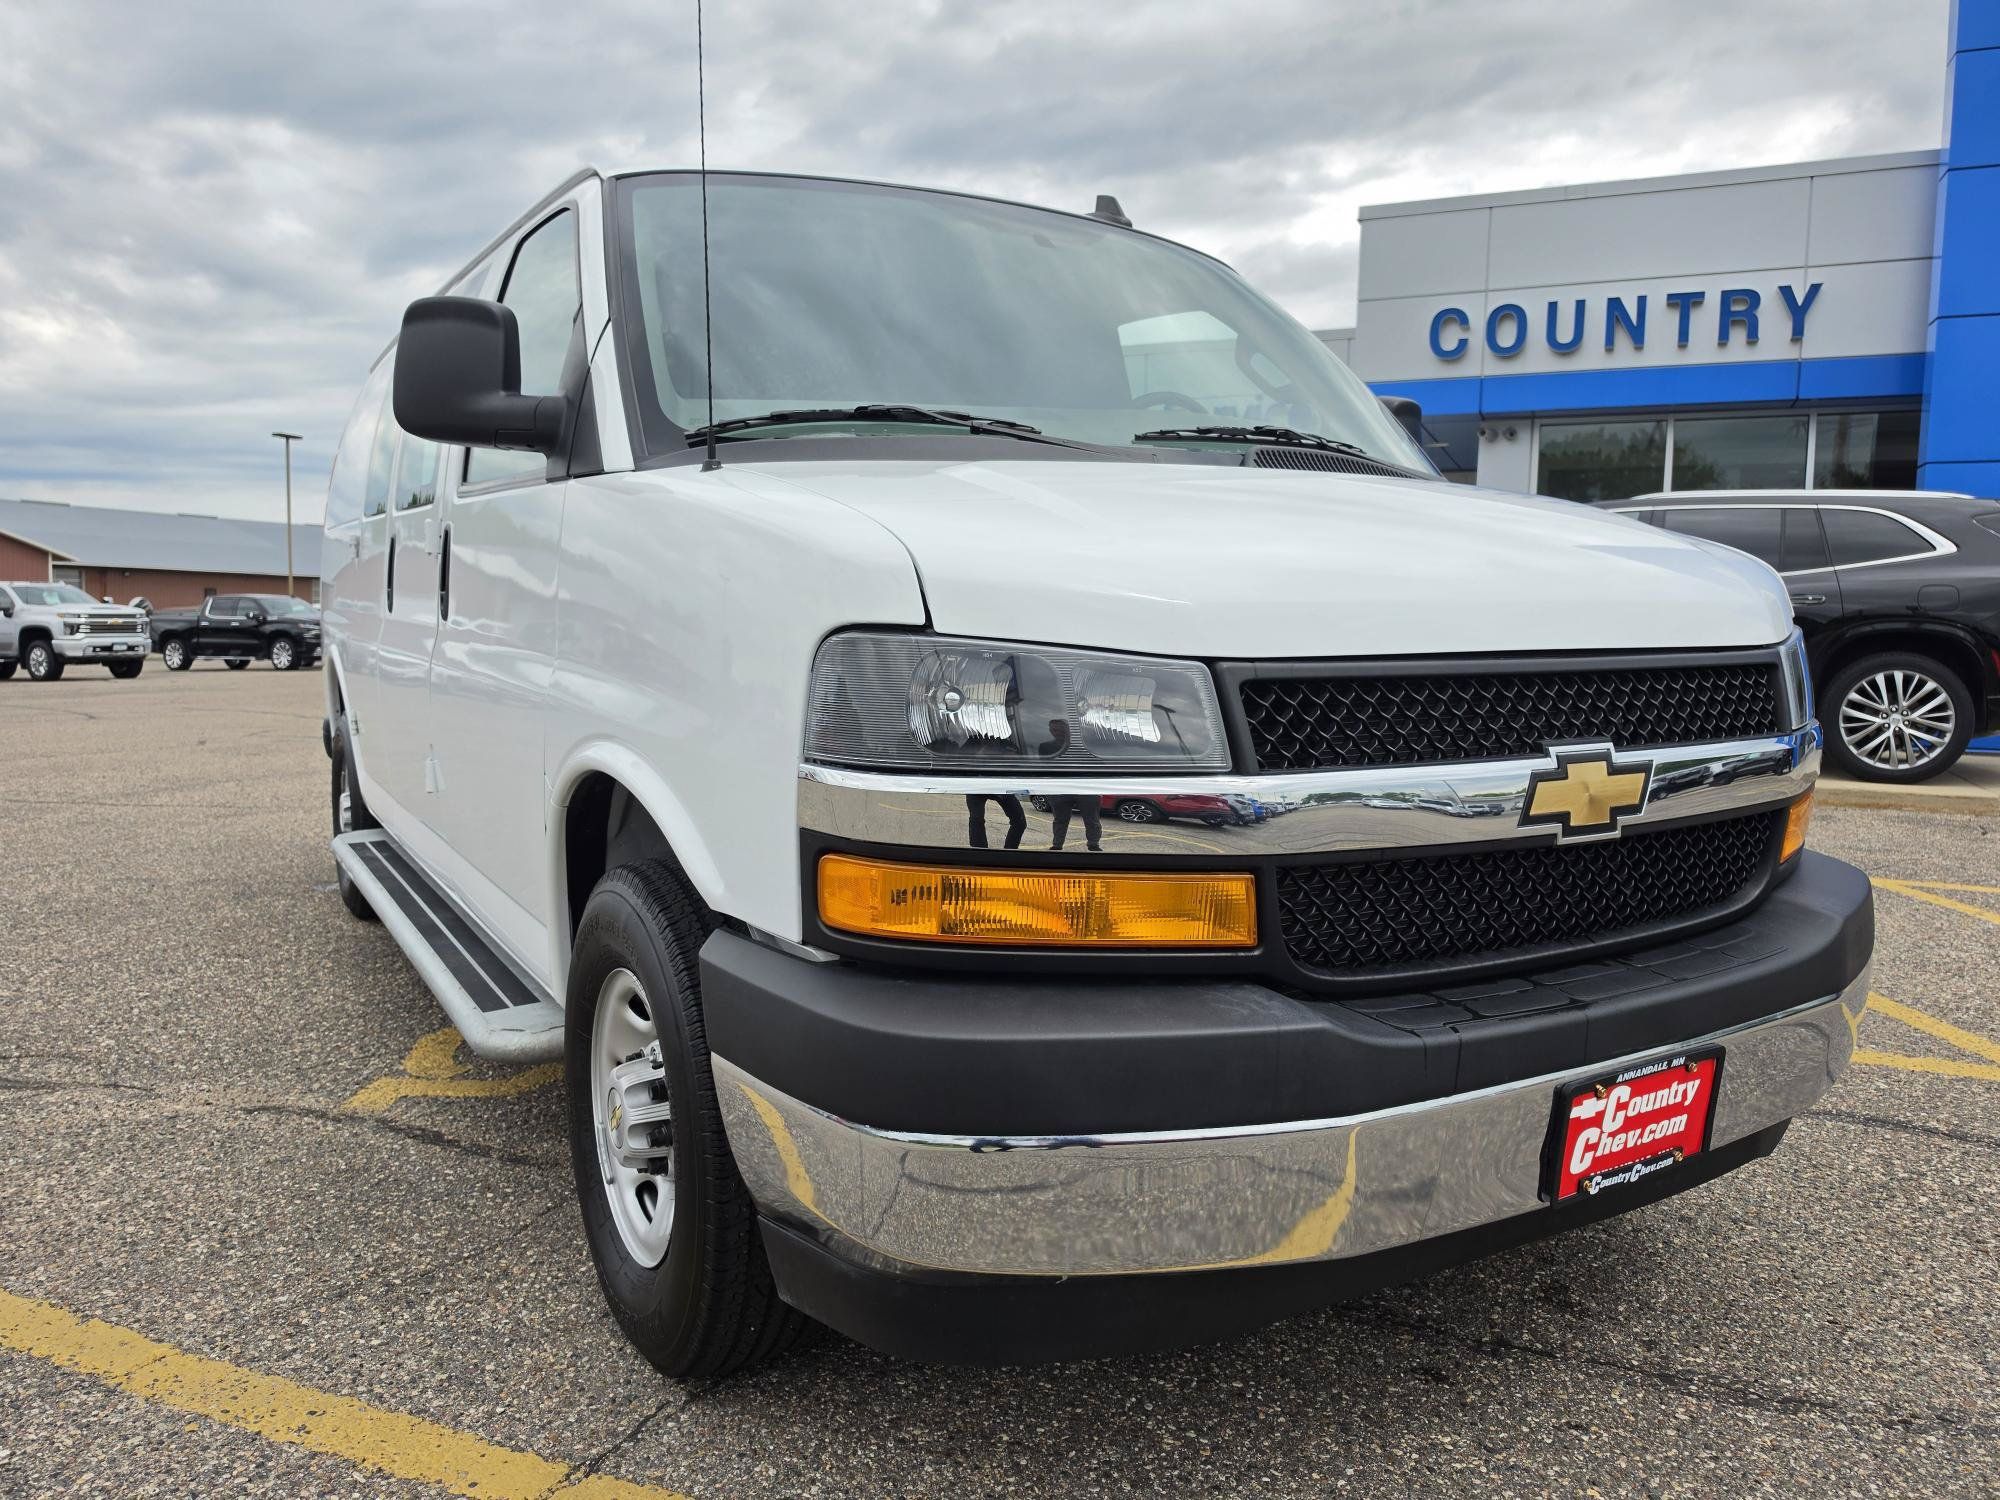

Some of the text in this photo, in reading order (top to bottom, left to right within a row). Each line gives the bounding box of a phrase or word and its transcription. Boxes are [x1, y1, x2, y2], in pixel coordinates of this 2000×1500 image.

[1429, 282, 1824, 360] COUNTRY
[1616, 1056, 1685, 1083] ANNANDALE MN
[1602, 1079, 1701, 1133] Country
[1569, 1113, 1688, 1175] Chev.com
[1589, 1157, 1674, 1194] CountryChev.com
